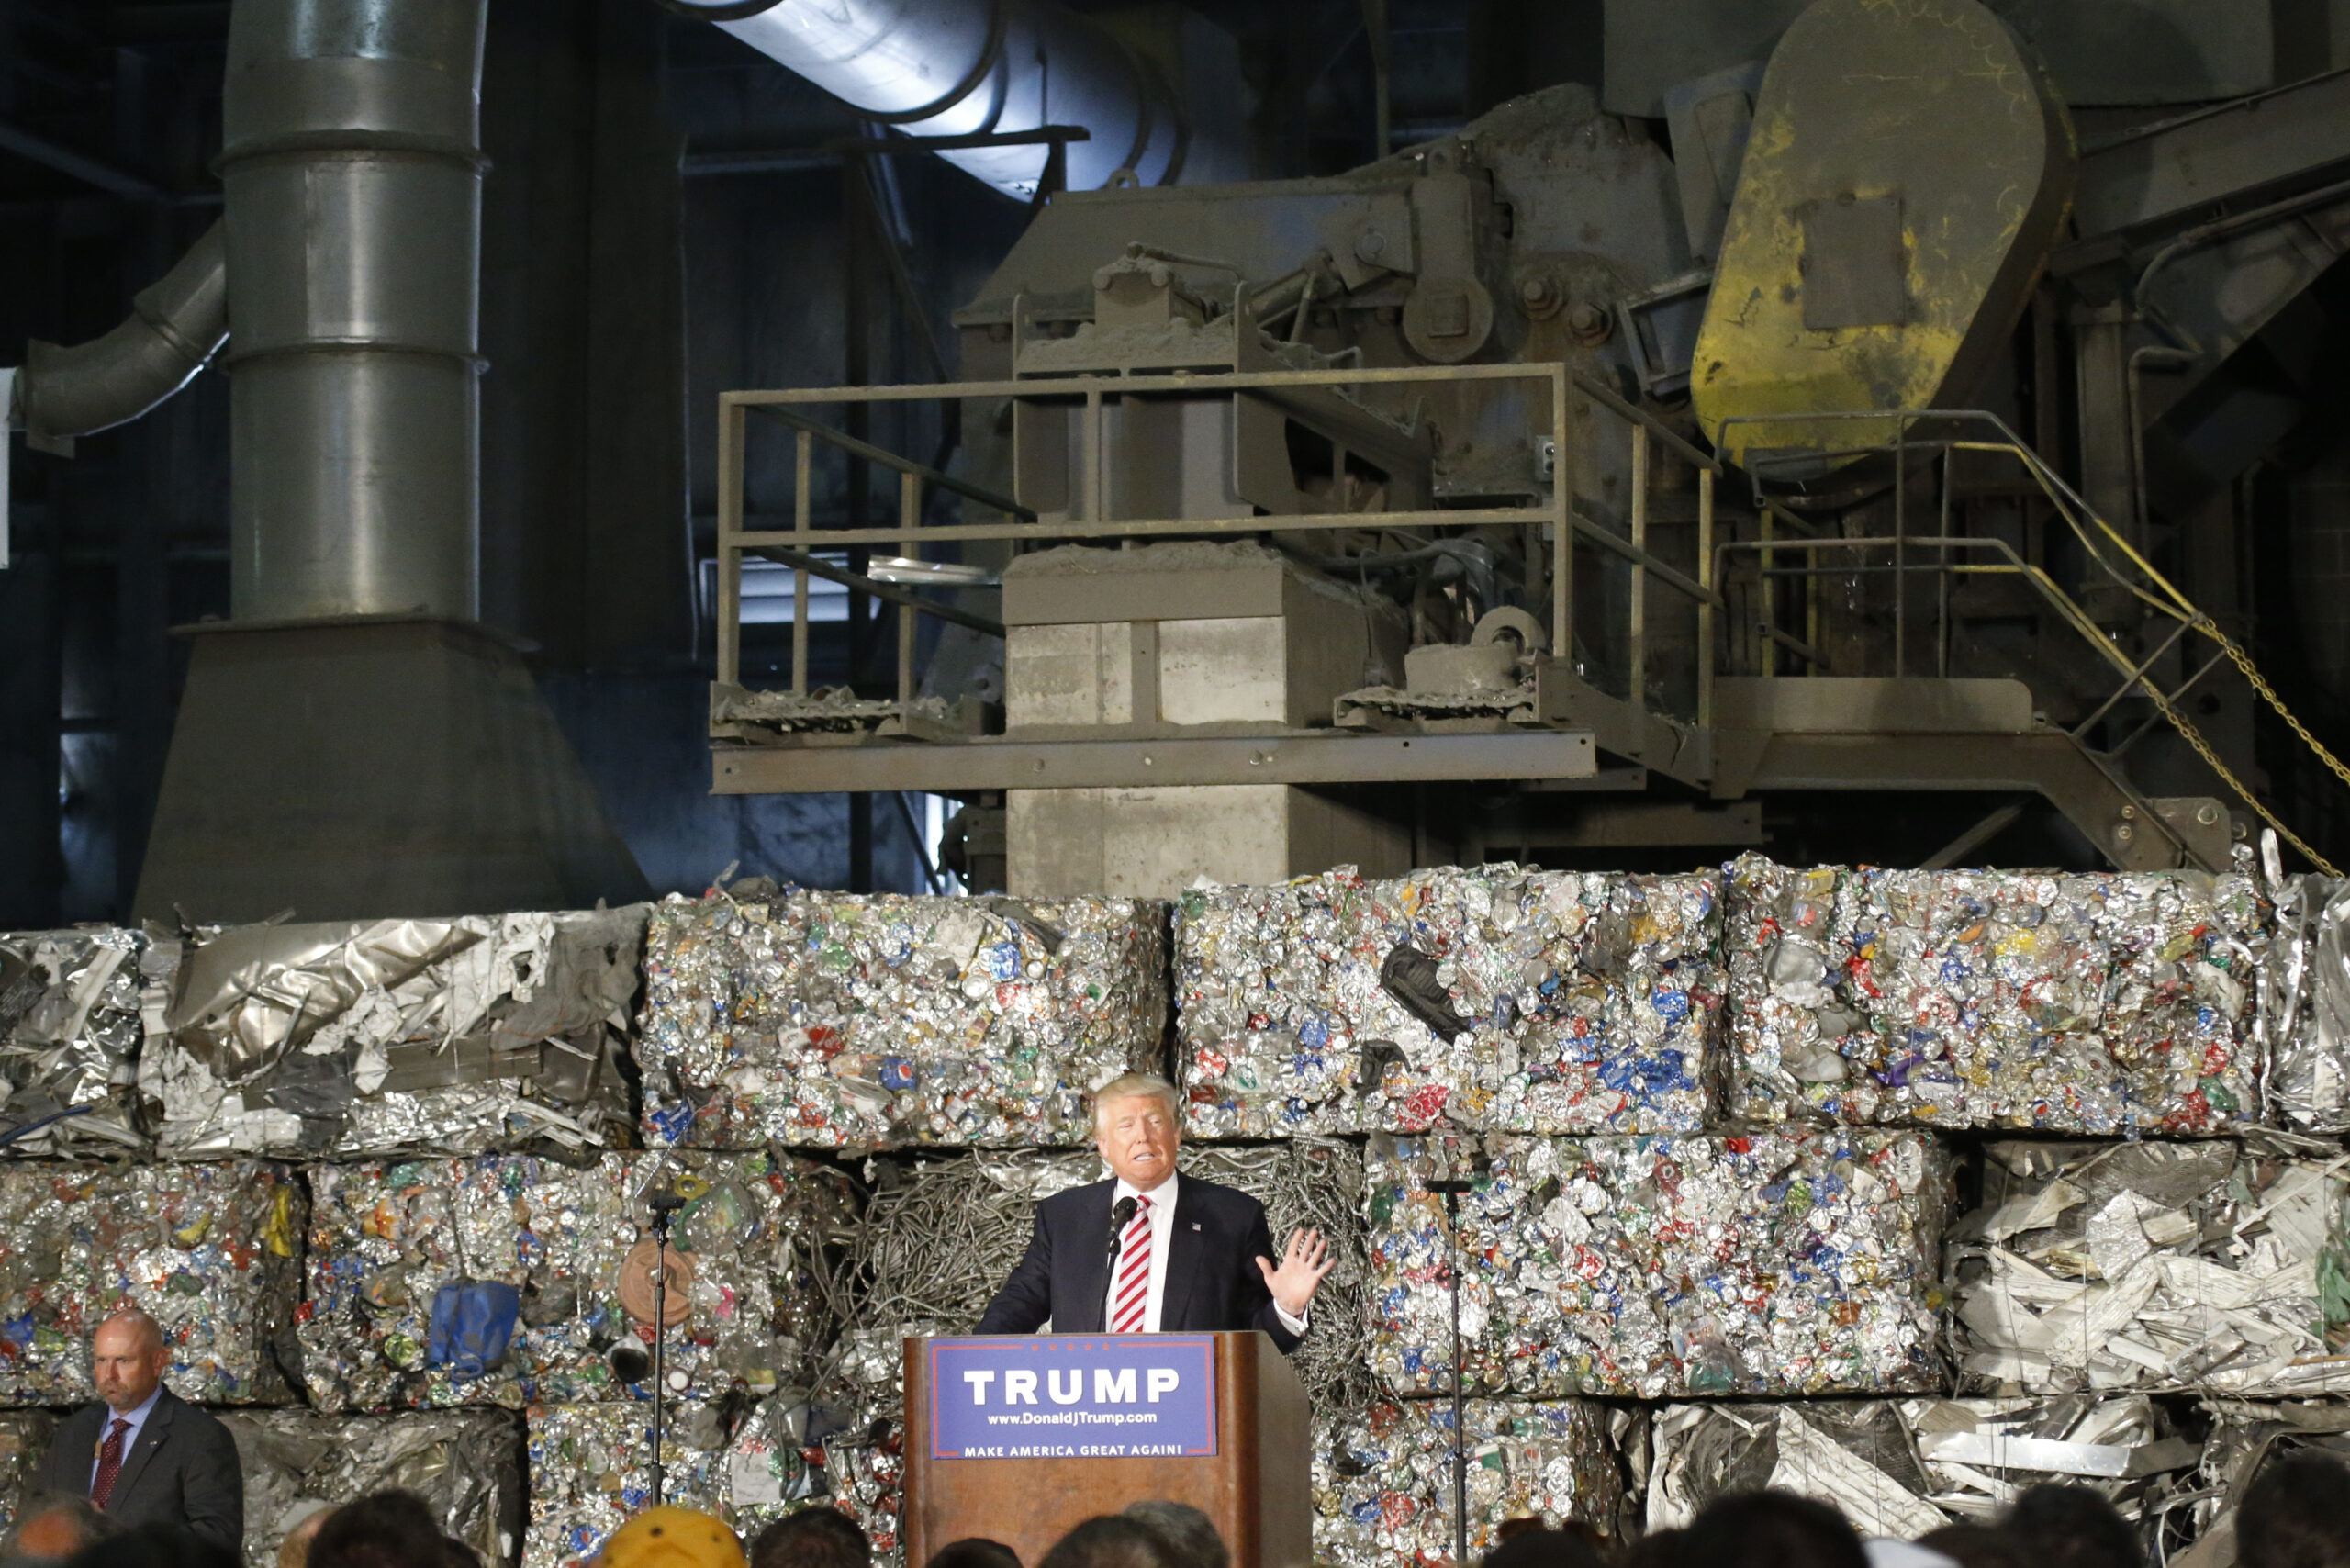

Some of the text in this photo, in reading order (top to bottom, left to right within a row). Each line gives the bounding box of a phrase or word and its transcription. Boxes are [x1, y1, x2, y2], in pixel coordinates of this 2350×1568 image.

[963, 1368, 1180, 1406] TRUMP
[987, 1411, 1158, 1426] www.DonaldJTrump.com
[964, 1444, 1181, 1458] MAKE AMERICA GREAT AGAIN!
